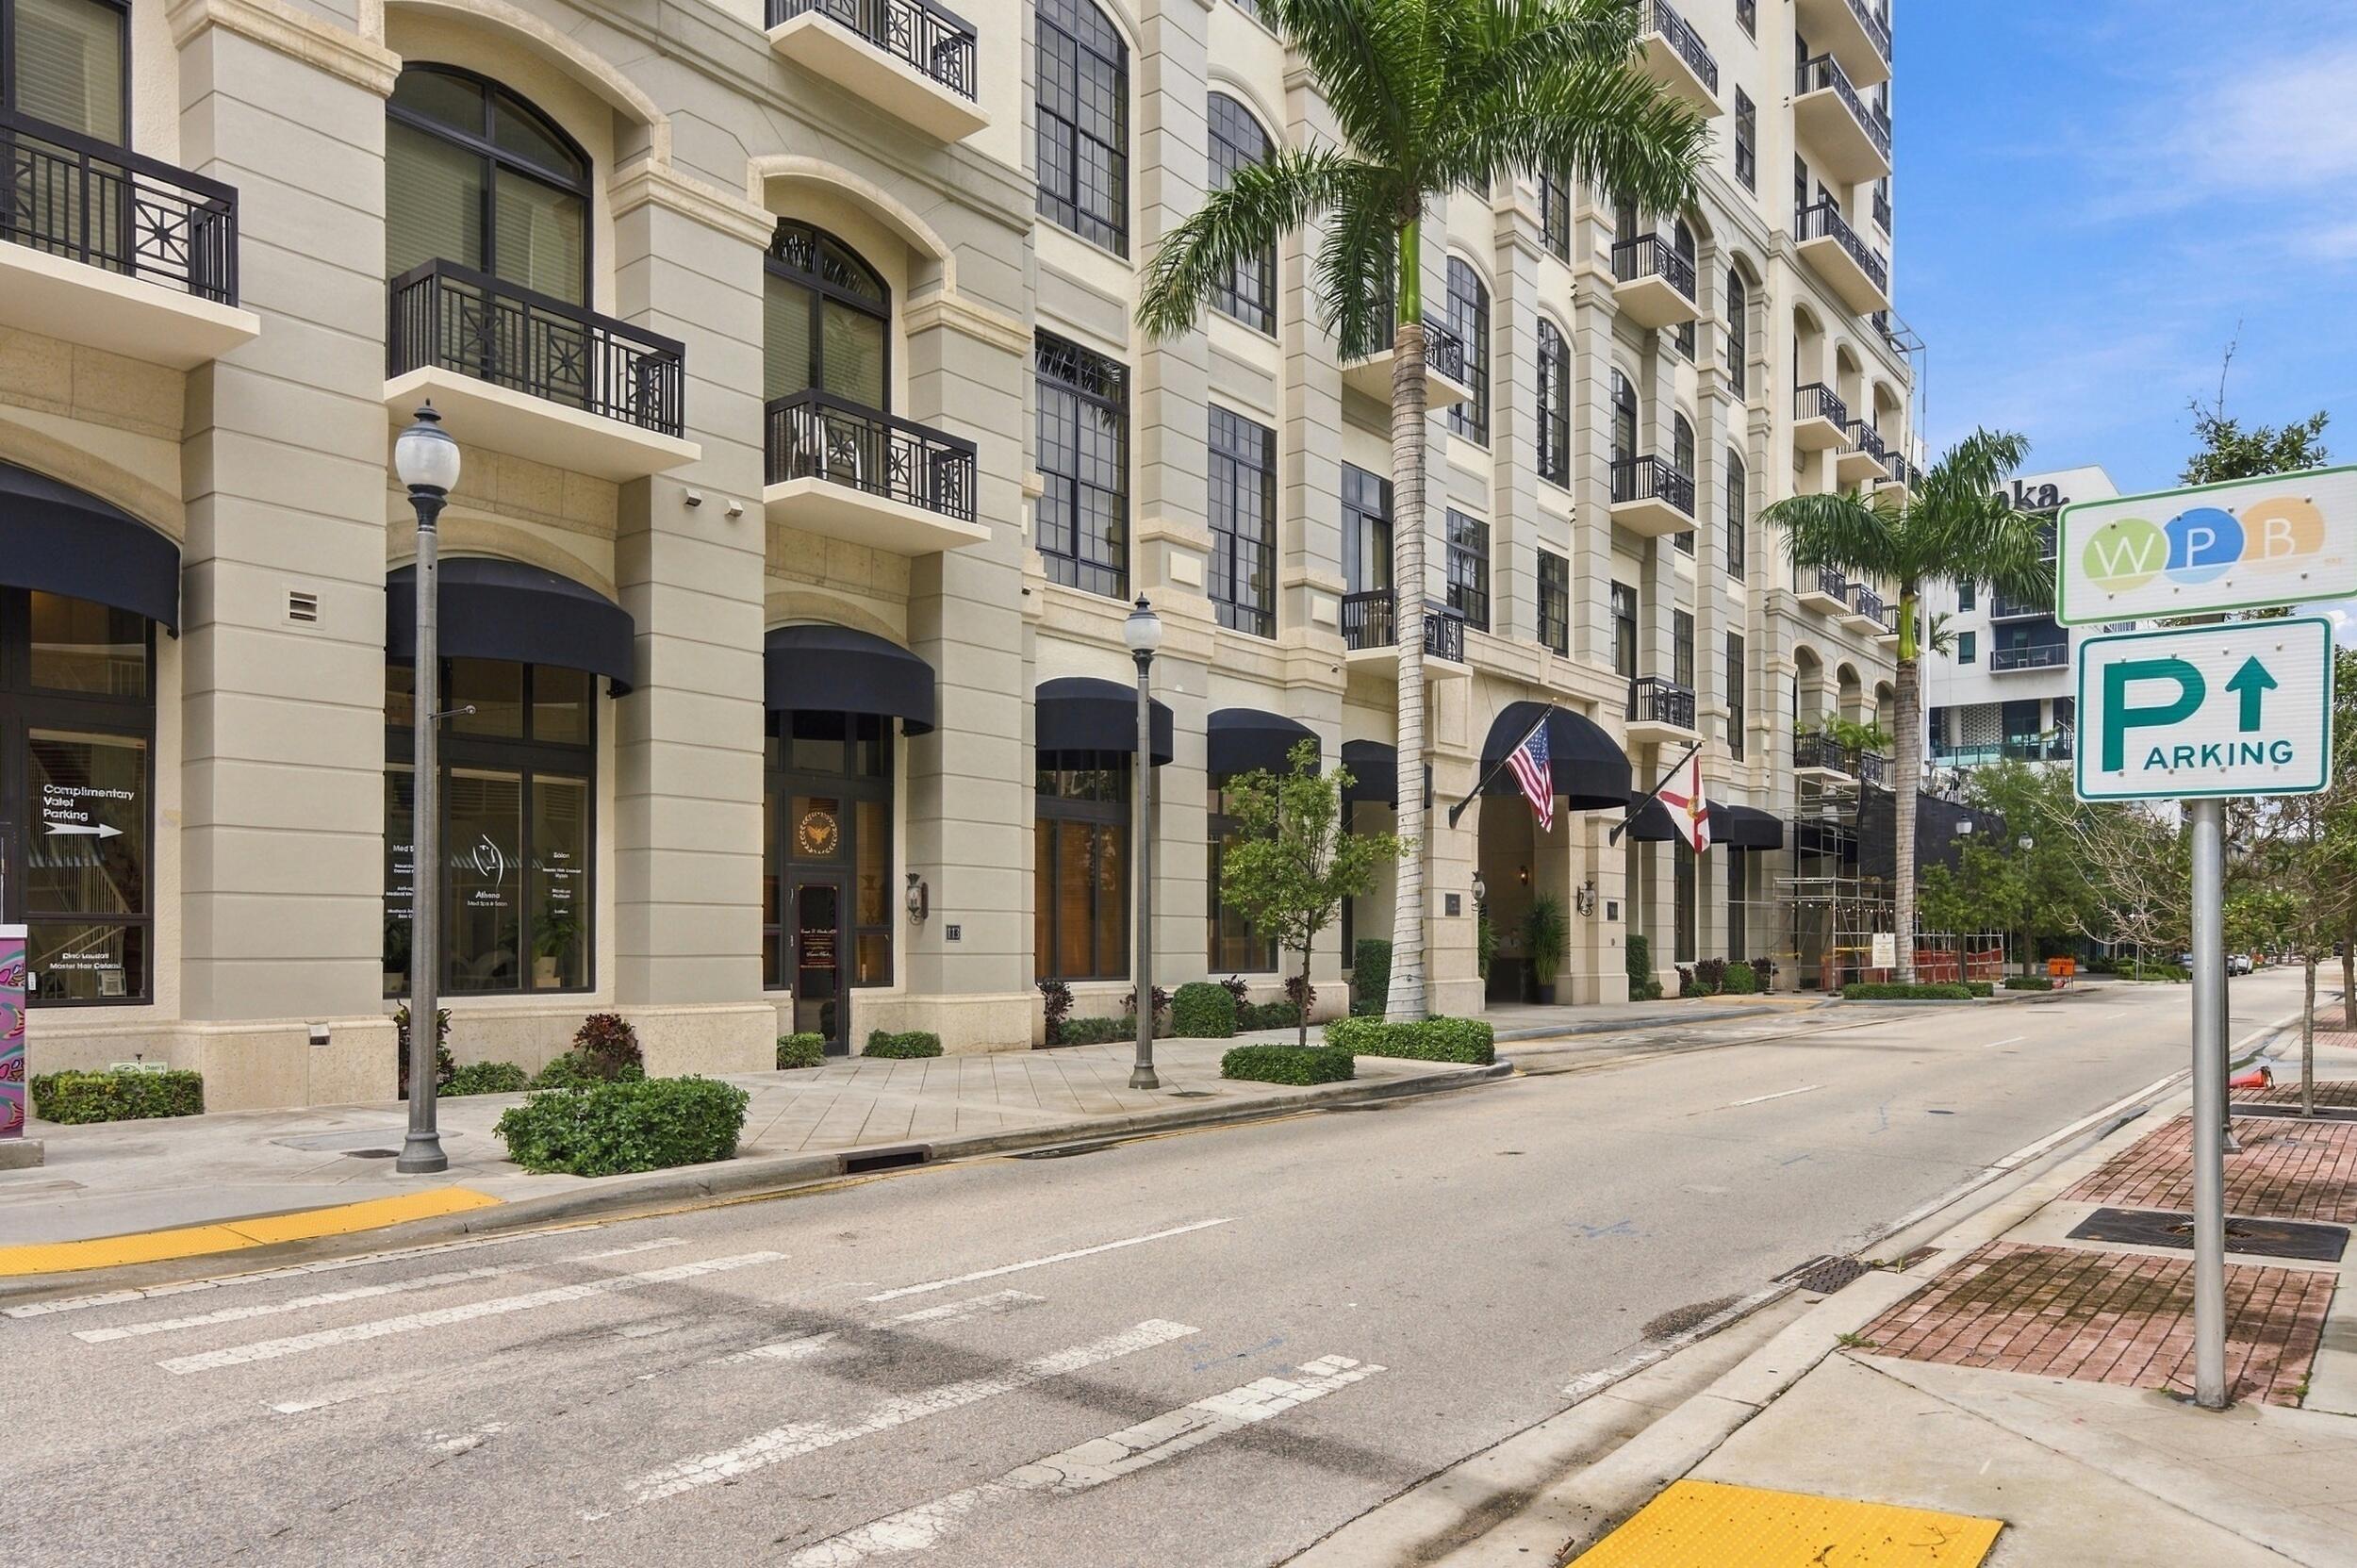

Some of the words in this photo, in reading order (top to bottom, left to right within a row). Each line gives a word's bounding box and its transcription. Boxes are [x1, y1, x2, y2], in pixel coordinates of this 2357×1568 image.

[43, 784, 134, 801] Complimentary
[43, 796, 74, 806] Valet
[43, 808, 88, 821] Parking
[475, 890, 501, 899] Athena
